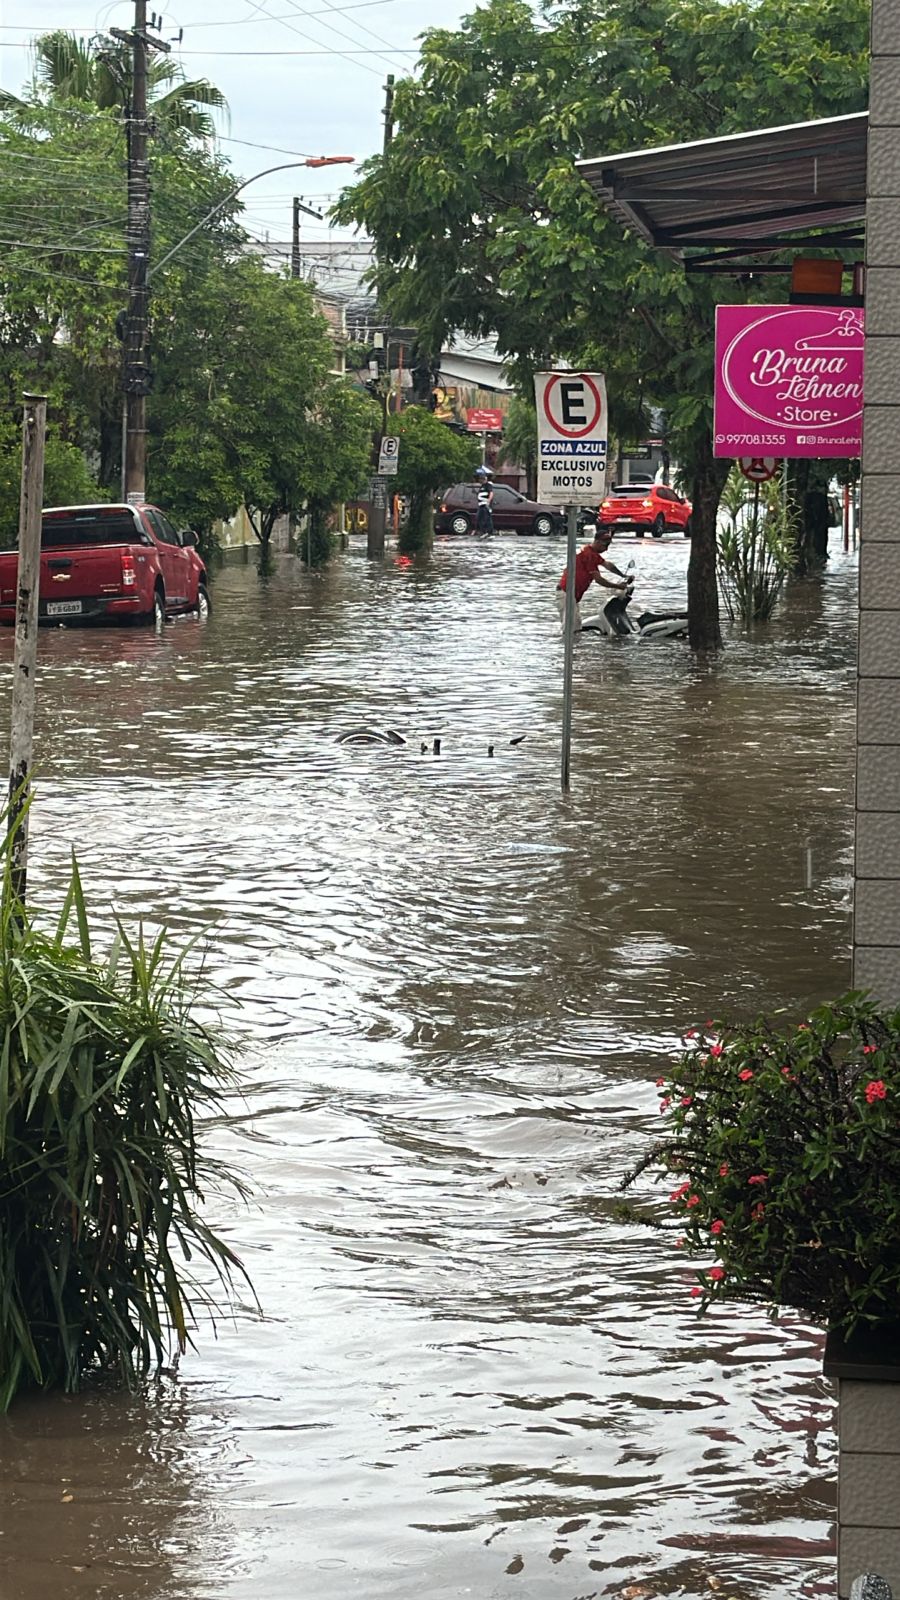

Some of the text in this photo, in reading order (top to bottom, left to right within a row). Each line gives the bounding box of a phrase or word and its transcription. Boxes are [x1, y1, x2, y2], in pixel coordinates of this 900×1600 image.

[750, 349, 847, 386] Bruna
[776, 375, 863, 402] Lehnen
[560, 383, 587, 424] E
[784, 406, 831, 421] Store
[387, 441, 394, 452] E
[542, 443, 606, 454] ZONA AZUL
[541, 460, 605, 471] EXCLUSIVO
[553, 476, 593, 487] MOTOS
